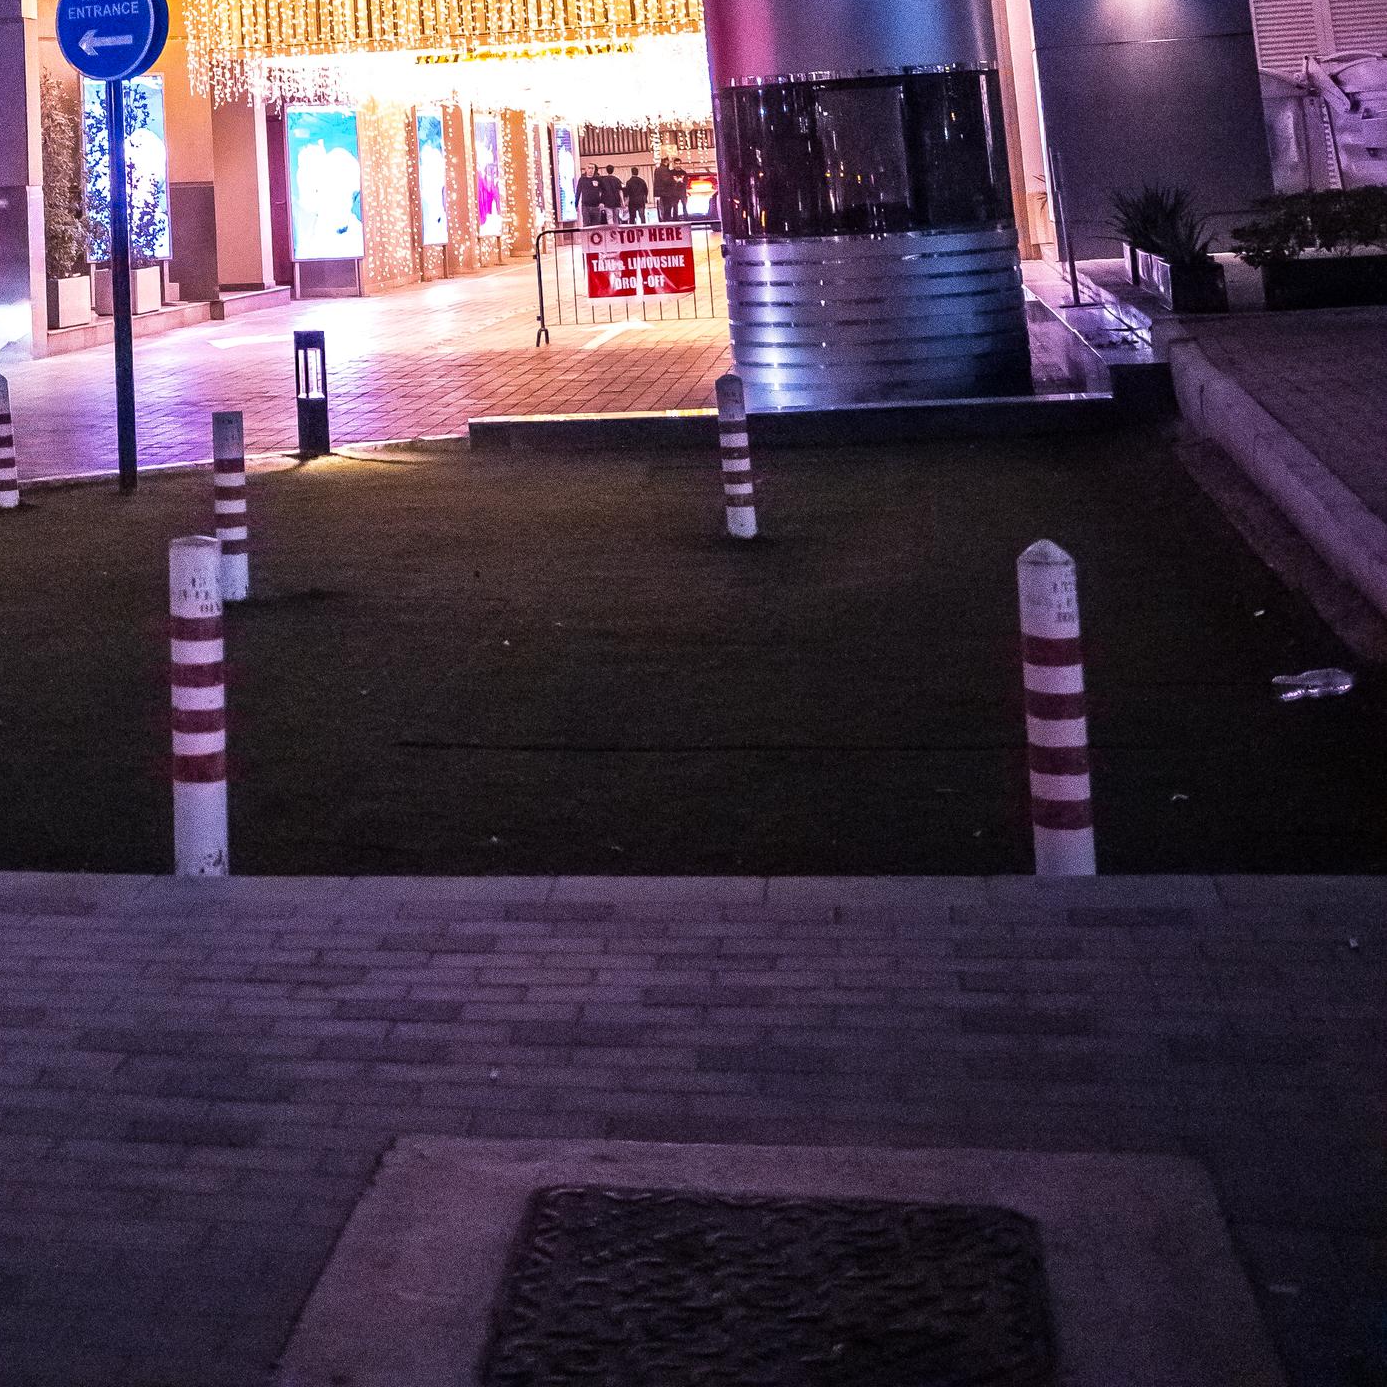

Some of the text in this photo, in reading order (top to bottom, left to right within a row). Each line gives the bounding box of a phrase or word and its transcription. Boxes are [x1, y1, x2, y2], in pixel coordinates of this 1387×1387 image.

[68, 1, 139, 20] ENTRANCE
[610, 227, 682, 244] STOP HERE
[627, 255, 685, 270] LIMOUSINE
[615, 274, 665, 289] DRO-OFF
